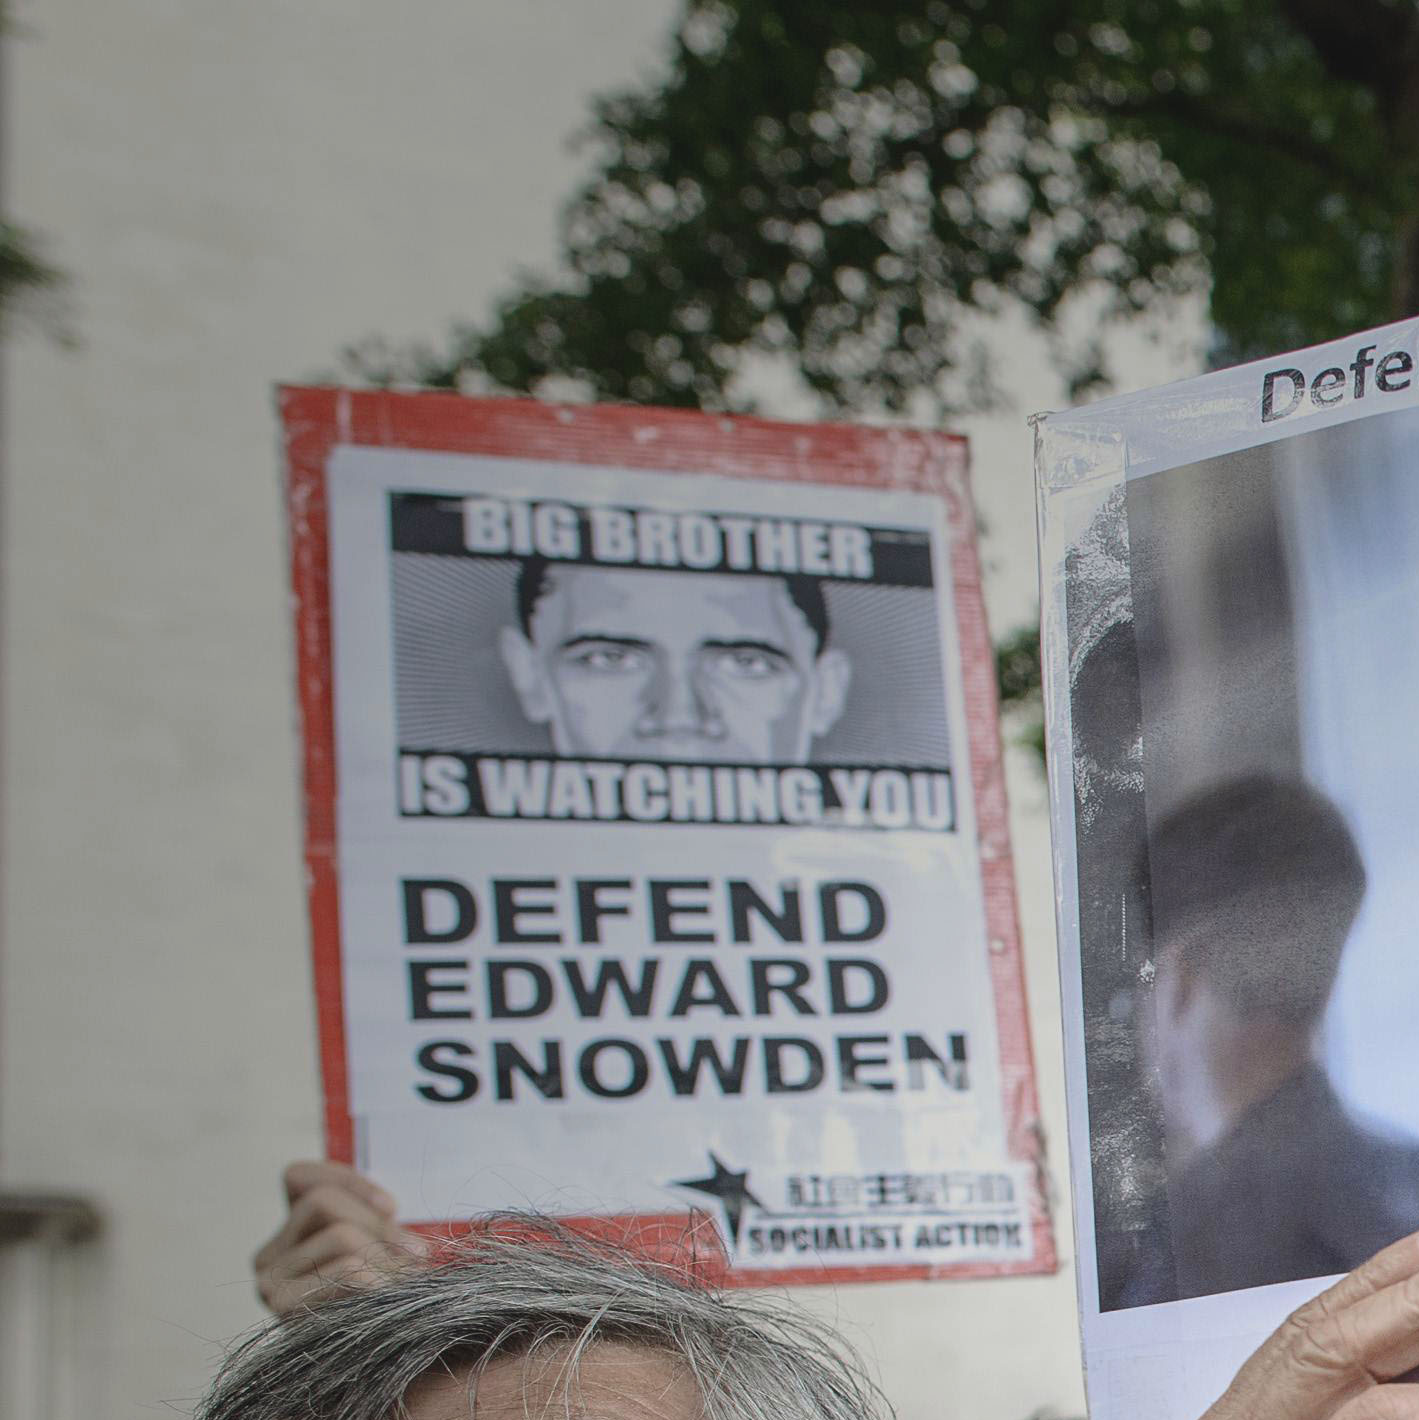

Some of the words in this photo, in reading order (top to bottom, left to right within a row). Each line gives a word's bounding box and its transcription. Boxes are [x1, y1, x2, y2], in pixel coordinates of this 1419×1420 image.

[463, 497, 581, 562] BIG
[599, 505, 873, 580] BROTHER
[401, 755, 470, 816] IS
[478, 759, 823, 827] WATCHING
[830, 768, 956, 830] YOU
[402, 877, 888, 945] DEFEND
[408, 957, 891, 1022] EDWARD
[414, 1031, 971, 1103] SNOWDEN
[748, 1222, 902, 1254] SOCIALIST
[915, 1221, 1022, 1249] ACTION
